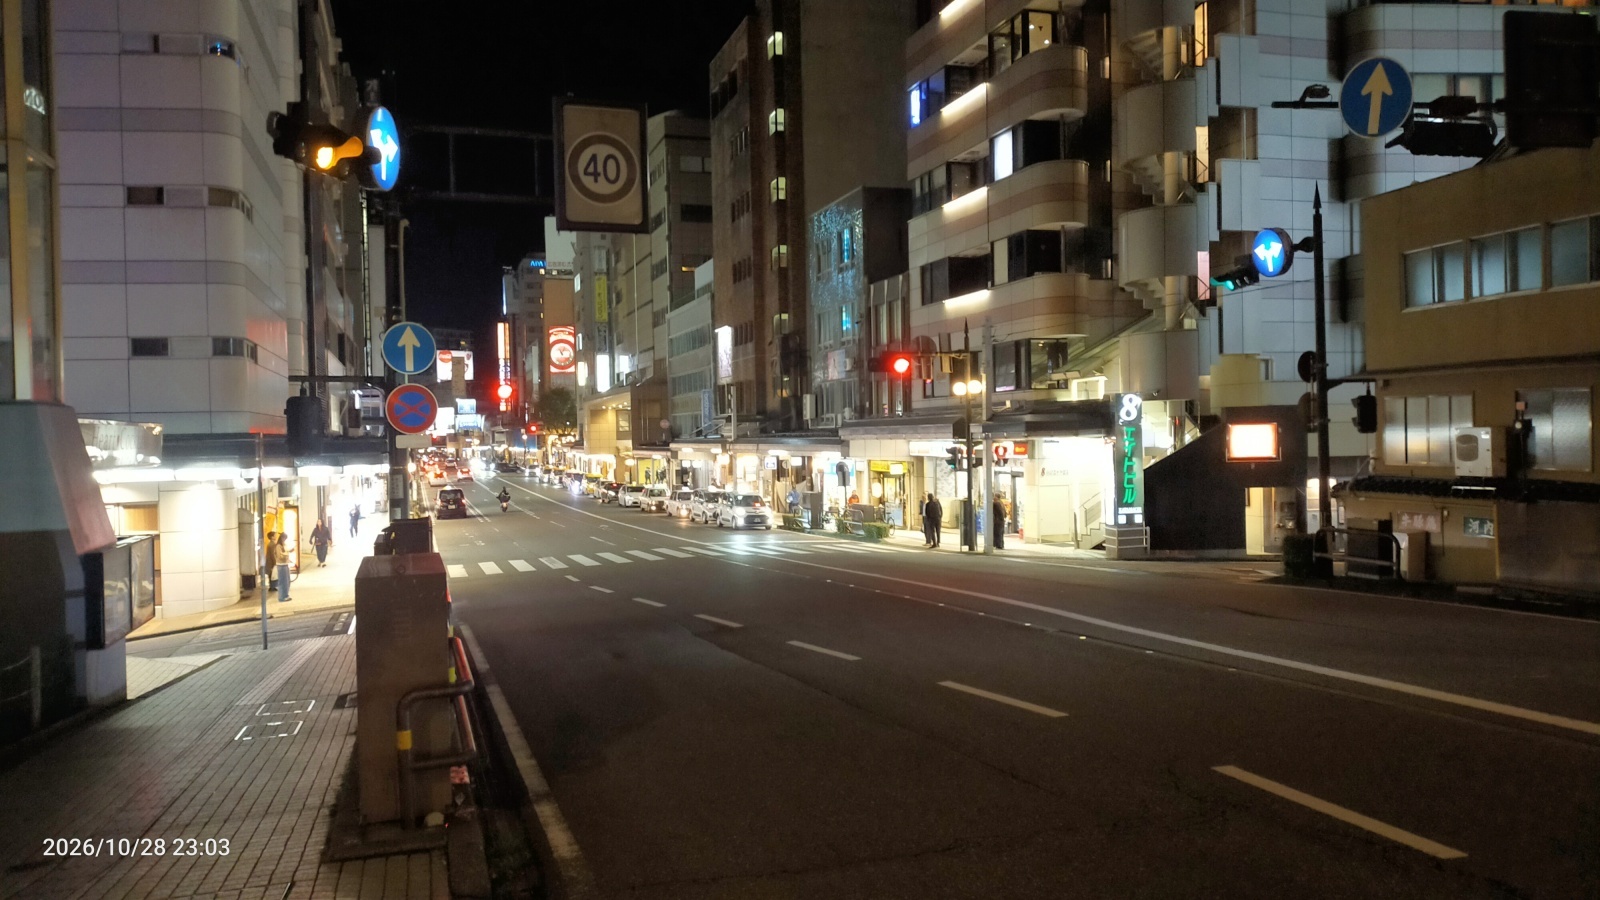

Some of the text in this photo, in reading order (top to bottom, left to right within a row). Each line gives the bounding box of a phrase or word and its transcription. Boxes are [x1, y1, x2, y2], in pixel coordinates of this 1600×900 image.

[584, 154, 620, 184] 40
[1119, 393, 1140, 421] 8
[1122, 427, 1137, 504] エイトビル
